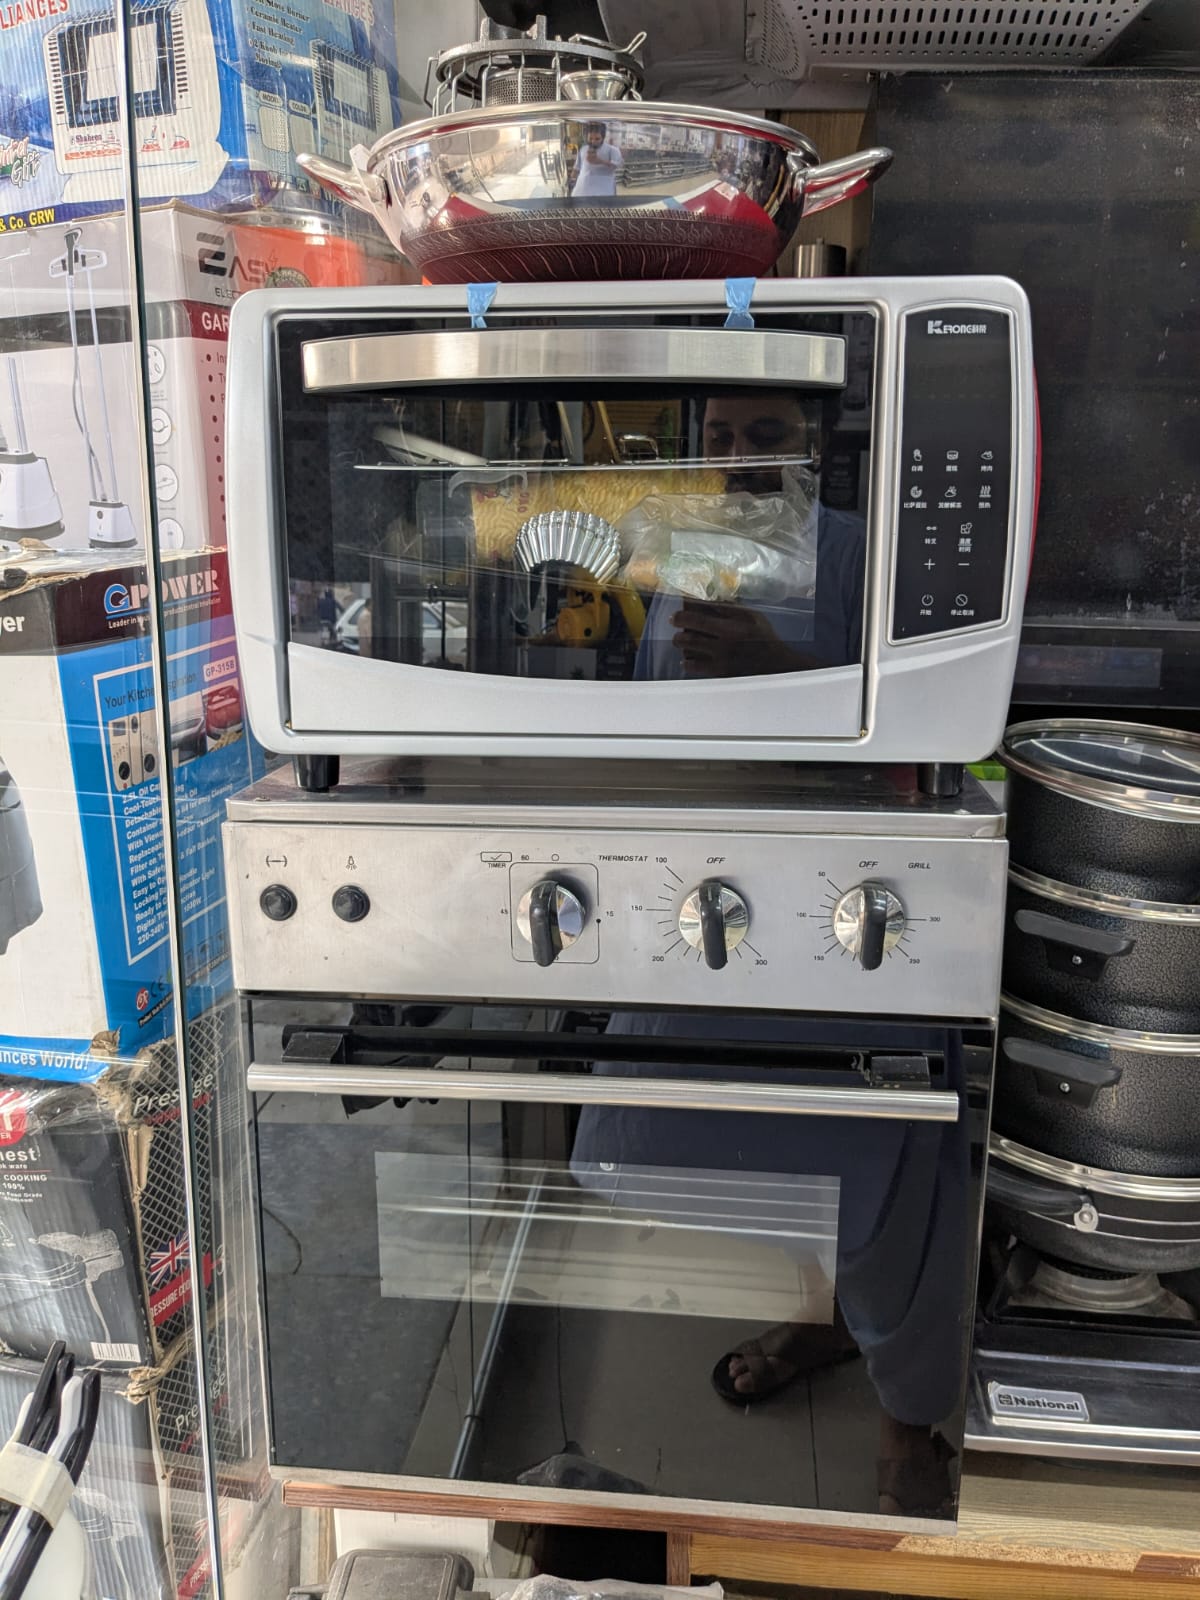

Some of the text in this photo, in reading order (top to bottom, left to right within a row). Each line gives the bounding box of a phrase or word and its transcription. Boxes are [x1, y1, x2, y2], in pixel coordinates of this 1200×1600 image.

[9, 215, 27, 231] Co.
[29, 208, 55, 226] GRW
[104, 692, 126, 709] Your
[130, 861, 148, 876] Filter
[858, 860, 878, 868] OFF
[40, 1051, 89, 1071] World!
[4, 1174, 48, 1182] COOKING
[1013, 1395, 1080, 1411] National
